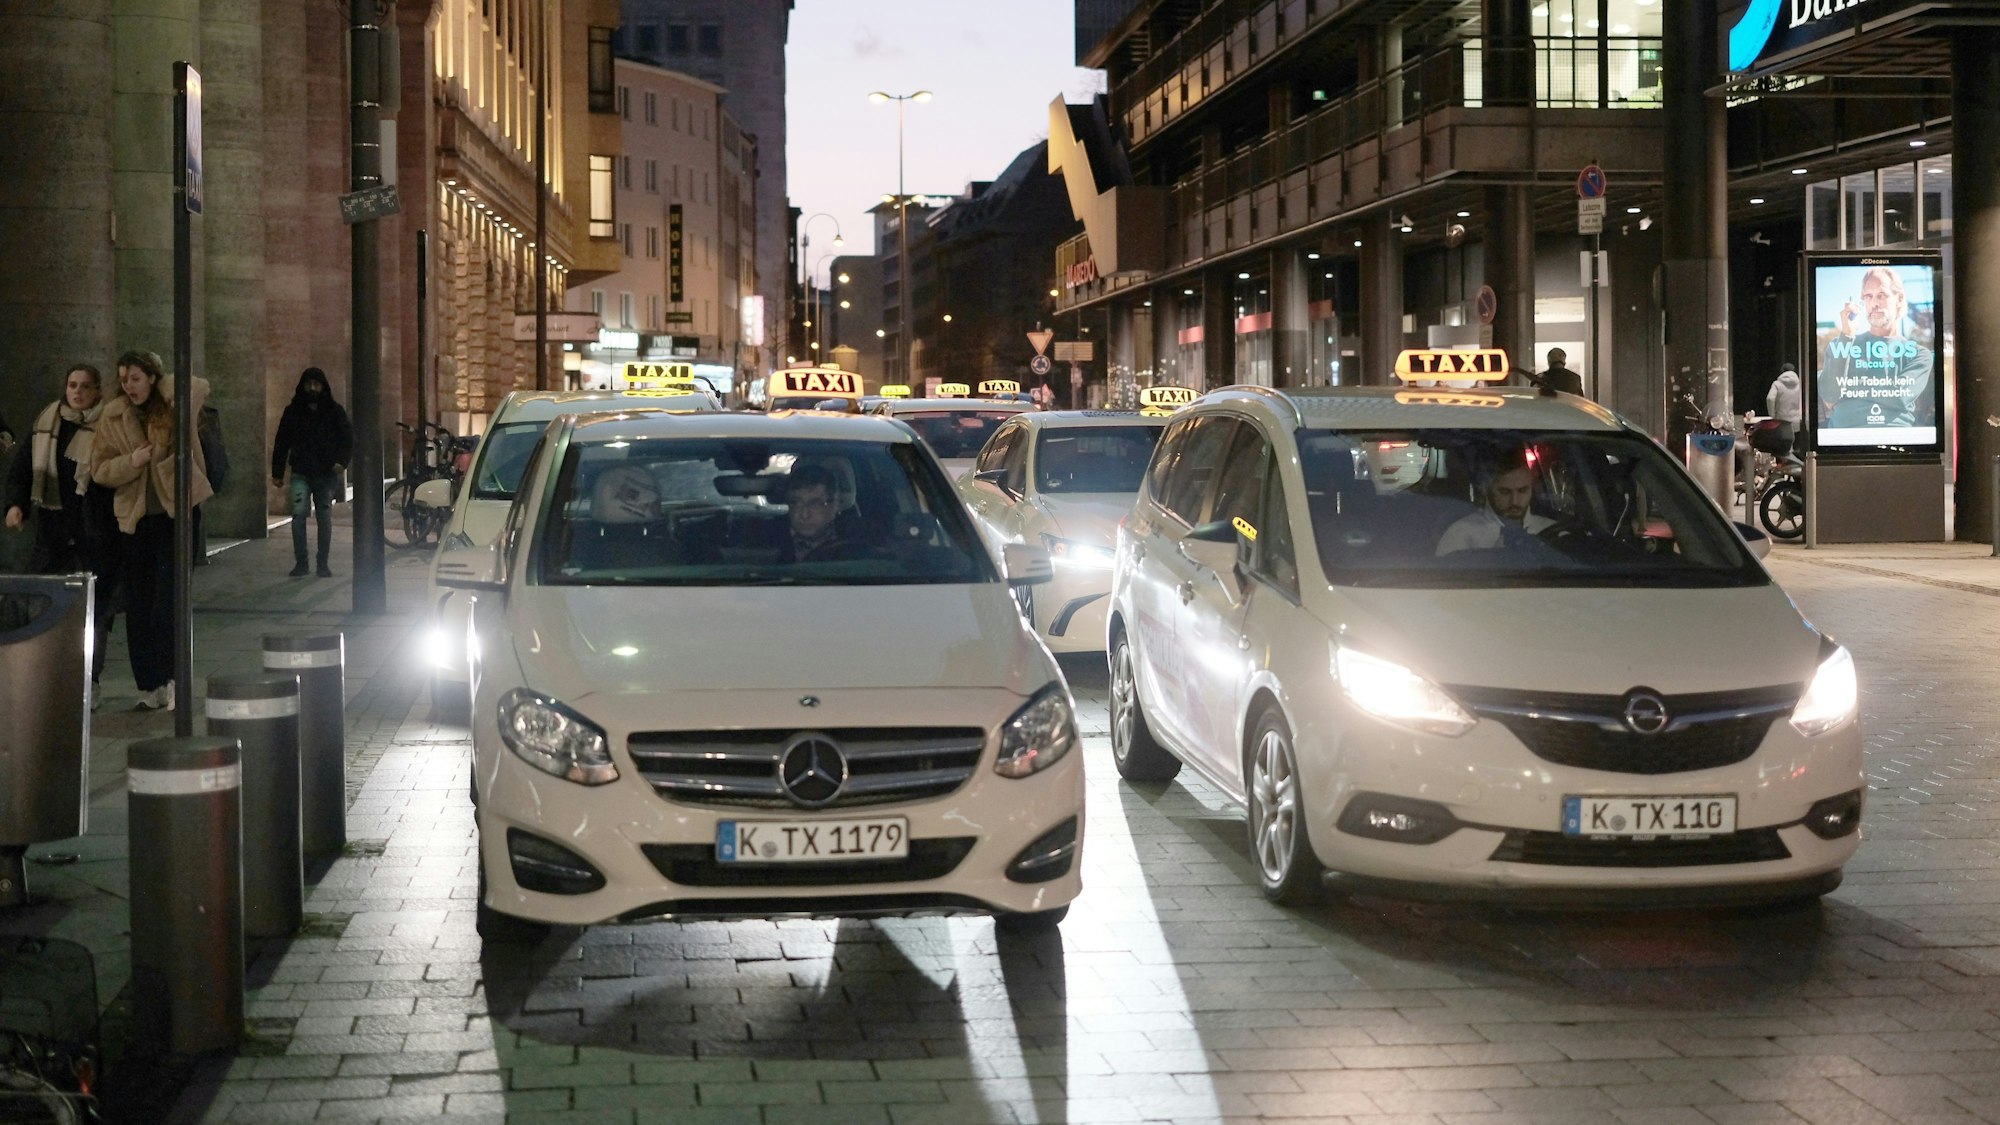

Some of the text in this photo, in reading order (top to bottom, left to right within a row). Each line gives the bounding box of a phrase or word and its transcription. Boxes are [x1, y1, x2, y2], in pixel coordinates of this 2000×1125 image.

[671, 213, 681, 293] HOTEL
[1829, 341, 1918, 359] We IQOS
[1418, 354, 1492, 373] TAXI
[1855, 360, 1896, 369] Because
[634, 365, 683, 378] TAXI
[789, 373, 851, 392] TAXI
[988, 383, 1014, 391] TAXI
[1836, 375, 1916, 387] Weil Tabak kein
[1152, 390, 1189, 403] TAXI
[1840, 387, 1914, 398] Feuer braucht.
[1592, 802, 1722, 829] K TX 110
[740, 824, 901, 856] K TX 1179
